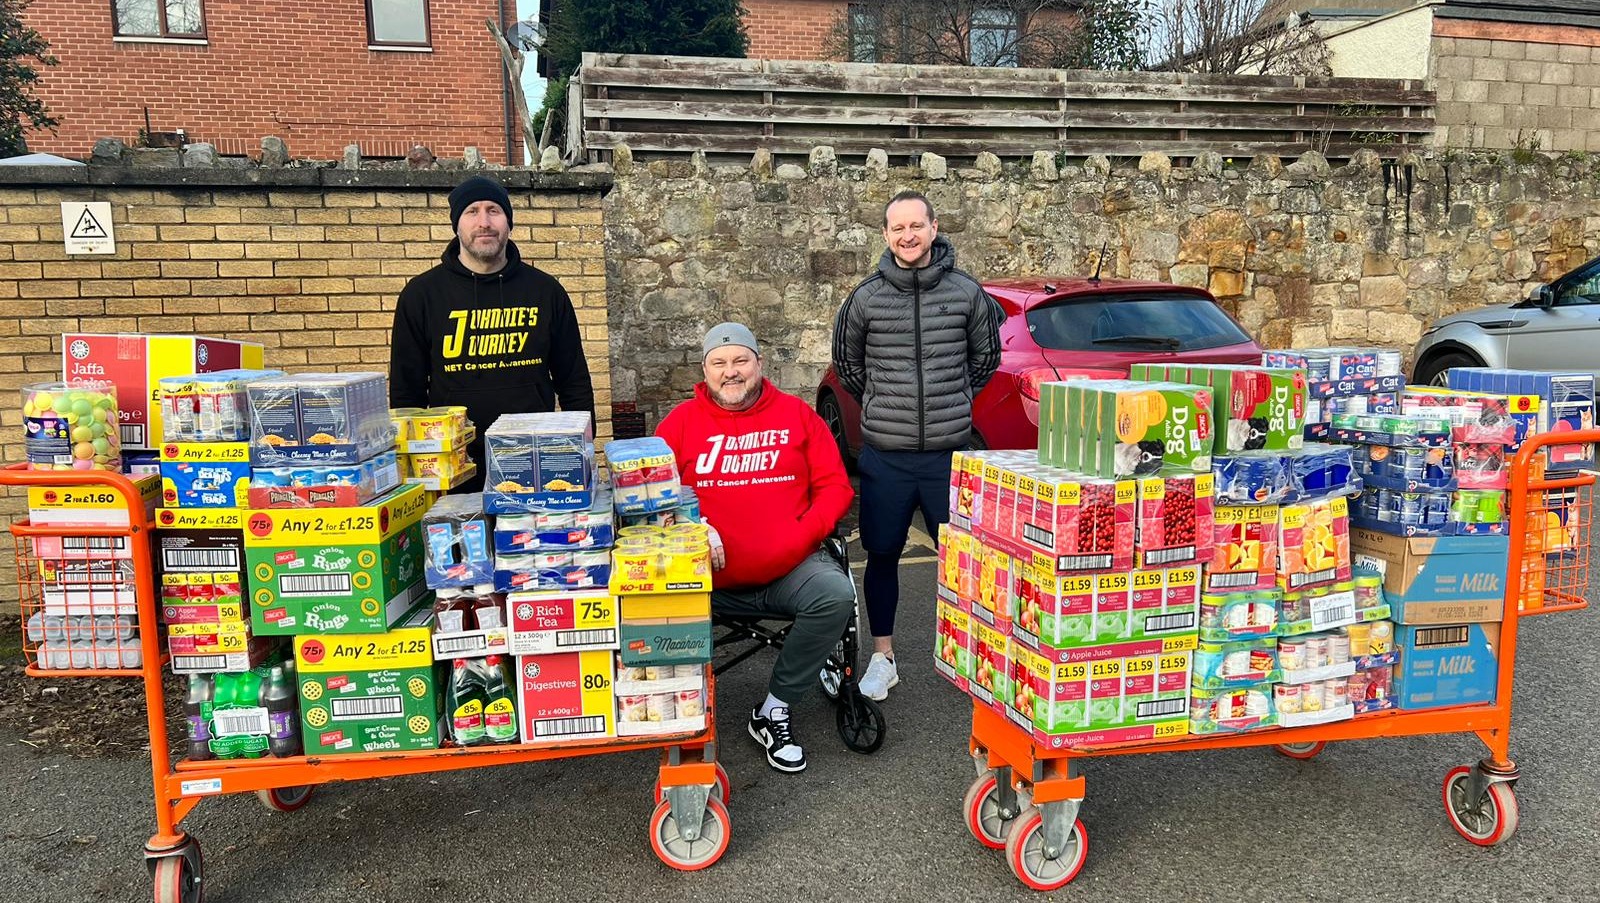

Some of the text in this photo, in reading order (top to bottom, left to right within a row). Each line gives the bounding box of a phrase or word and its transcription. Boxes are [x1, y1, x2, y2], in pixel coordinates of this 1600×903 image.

[71, 362, 105, 375] Jaffa
[444, 357, 542, 372] NET Cancer Awareness
[1338, 382, 1355, 391] Cat
[1382, 378, 1399, 387] Cat
[1269, 386, 1289, 434] Dog
[1375, 406, 1393, 414] Cat
[1166, 406, 1188, 457] Dog
[183, 449, 203, 458] Any
[206, 449, 212, 457] 2
[221, 449, 244, 457] £1.25
[985, 468, 999, 480] £1.59
[1001, 471, 1016, 486] £1.59
[696, 474, 796, 488] NET Cancer Awareness
[1019, 477, 1034, 492] £1.59
[1037, 481, 1053, 498] £1.59
[64, 494, 71, 503] 2
[83, 493, 115, 503] £1.60
[309, 490, 336, 503] PRINGLES
[178, 516, 238, 525] Any 2 £1.25
[281, 517, 374, 534] Any 2 for £1.25
[320, 547, 345, 556] Onion
[312, 554, 352, 571] Rings
[1361, 560, 1379, 571] Milk
[1135, 574, 1161, 586] £1.59
[1169, 571, 1195, 582] £1.59
[1460, 573, 1499, 592] Milk
[620, 584, 654, 592] KO-LEE
[1064, 579, 1091, 591] £1.59
[1099, 577, 1126, 589] £1.59
[221, 607, 238, 617] 50p
[313, 602, 341, 613] Onion
[536, 605, 564, 615] Rich
[581, 602, 610, 620] 75p
[304, 612, 349, 631] Rings
[537, 618, 558, 627] Tea
[223, 637, 241, 648] 50p
[654, 635, 706, 652] Macaroni
[1164, 641, 1184, 650] £1.59
[333, 645, 363, 659] Any
[366, 643, 376, 656] 2
[391, 640, 426, 654] £1.25
[1071, 649, 1112, 660] Apple Juice
[1093, 663, 1119, 675] £1.59
[1127, 660, 1153, 672] £1.59
[1160, 657, 1186, 669] £1.59
[1437, 655, 1475, 676] Milk
[1058, 666, 1085, 678] £1.59
[526, 679, 577, 692] Digestives
[584, 674, 610, 689] 80p
[366, 684, 401, 695] Wheels
[464, 703, 478, 714] 85p
[493, 702, 507, 712] 85p
[553, 708, 570, 716] 400g
[1155, 726, 1175, 735] £1.59
[363, 739, 401, 751] Wheels
[1064, 734, 1105, 745] Apple Juice
